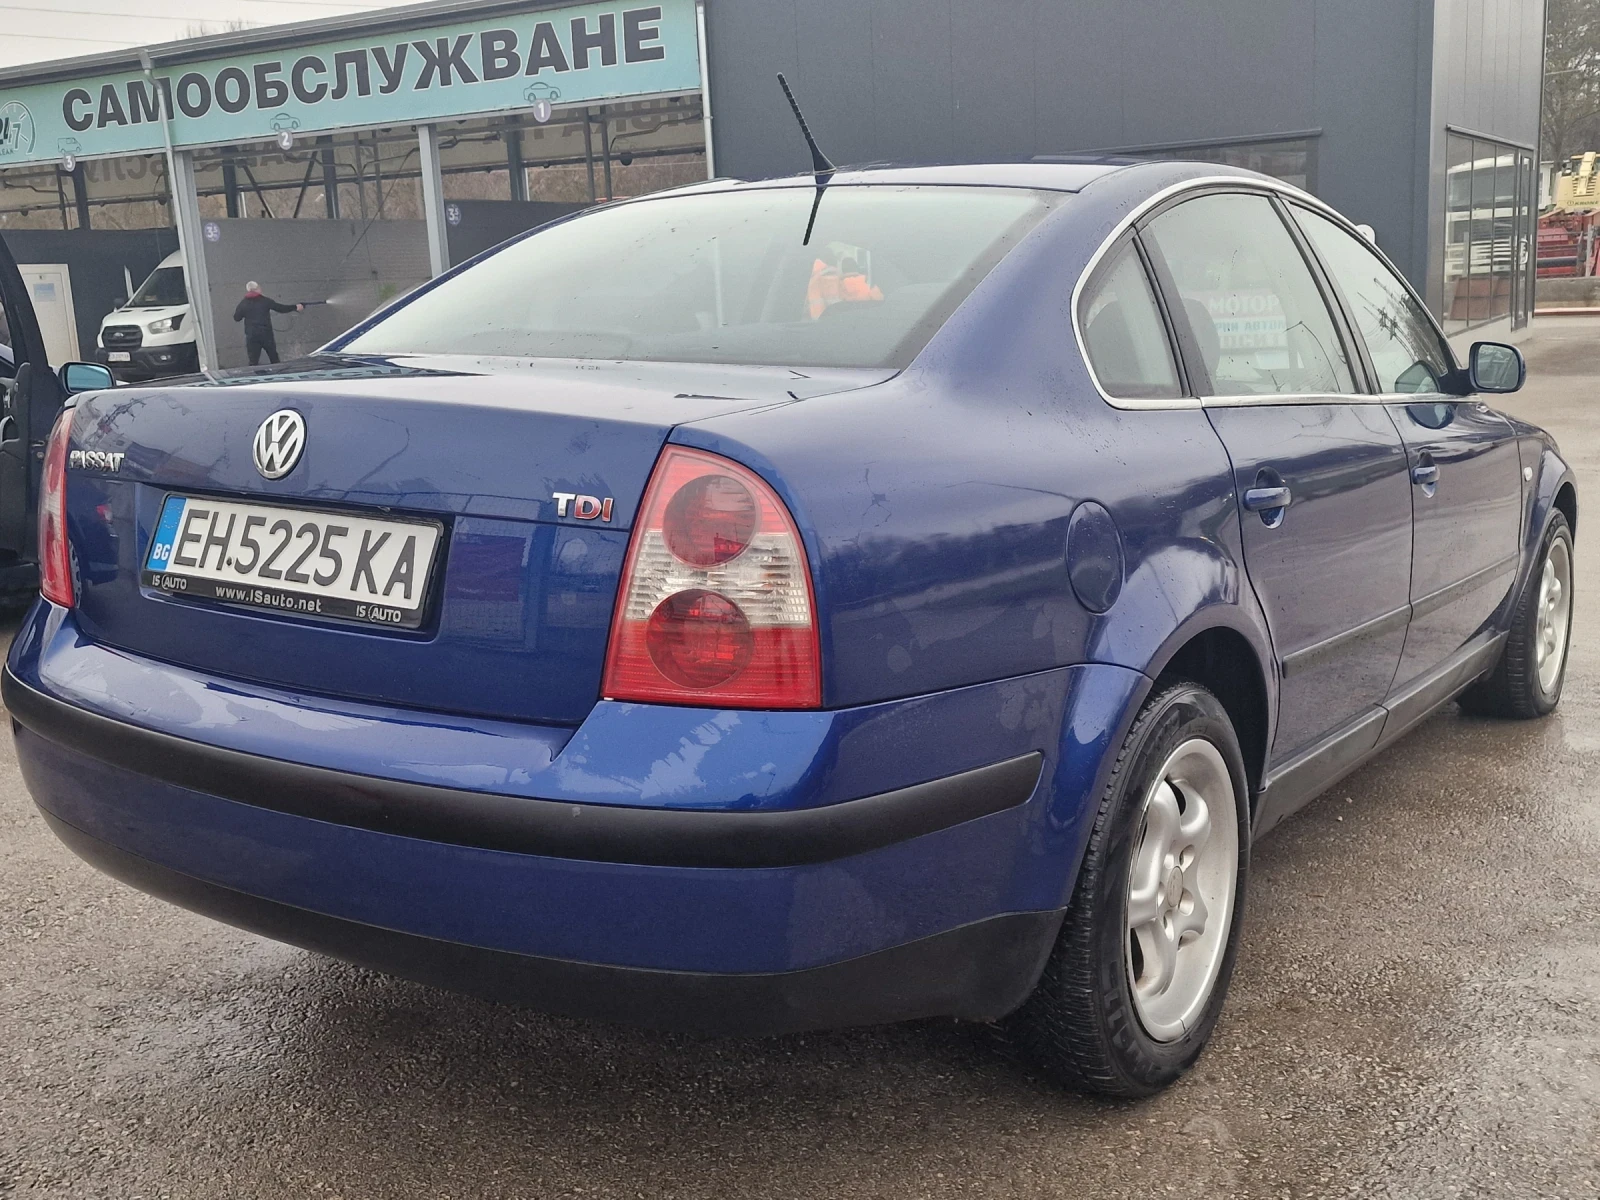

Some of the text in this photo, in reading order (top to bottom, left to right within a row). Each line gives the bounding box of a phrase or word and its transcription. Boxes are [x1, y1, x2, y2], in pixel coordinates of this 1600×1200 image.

[62, 7, 665, 132] САМООБСЛУЖВАНЕ
[70, 450, 125, 472] PASSAT
[552, 492, 613, 522] TDI
[153, 543, 170, 561] BG
